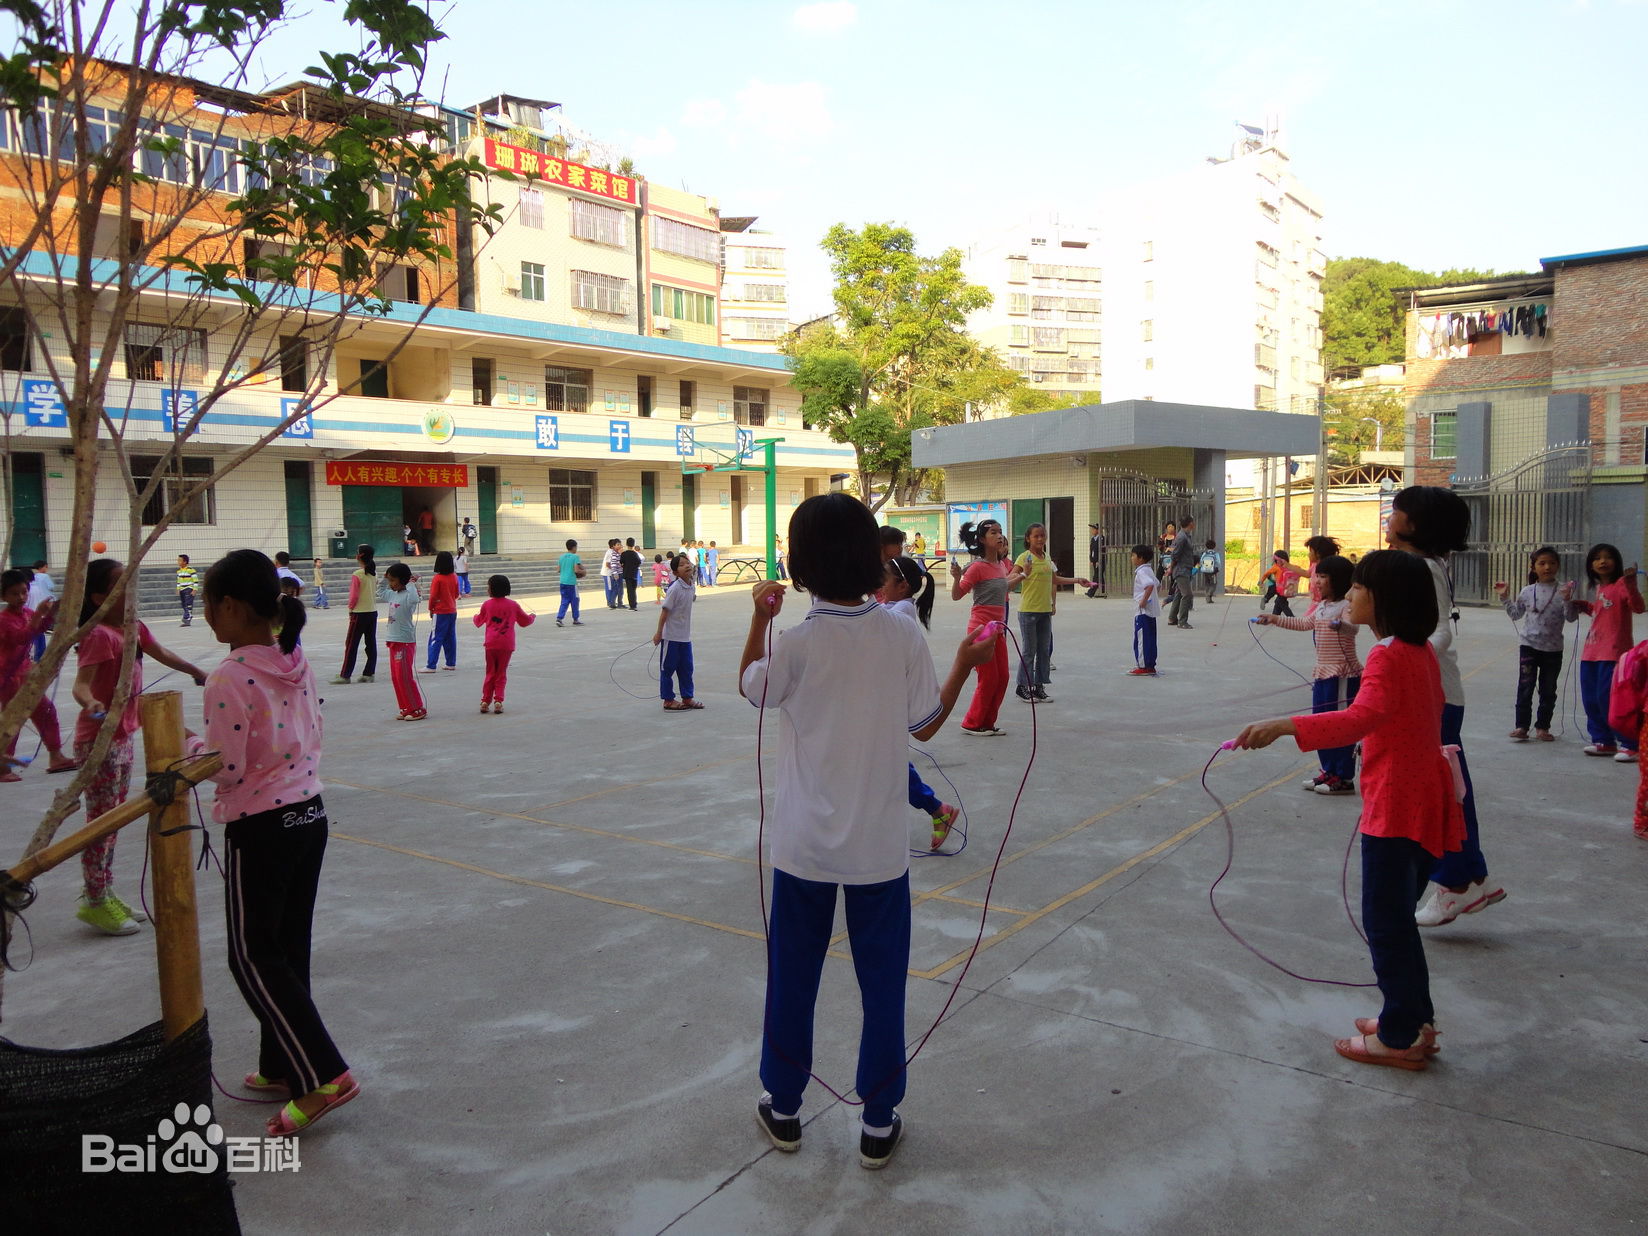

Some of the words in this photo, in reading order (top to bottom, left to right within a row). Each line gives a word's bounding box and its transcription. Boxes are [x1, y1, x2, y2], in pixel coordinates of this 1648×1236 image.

[495, 144, 628, 199] 珊瑚农家菜馆
[28, 384, 61, 424] 学
[537, 419, 557, 447] 敢
[611, 424, 628, 450] 于
